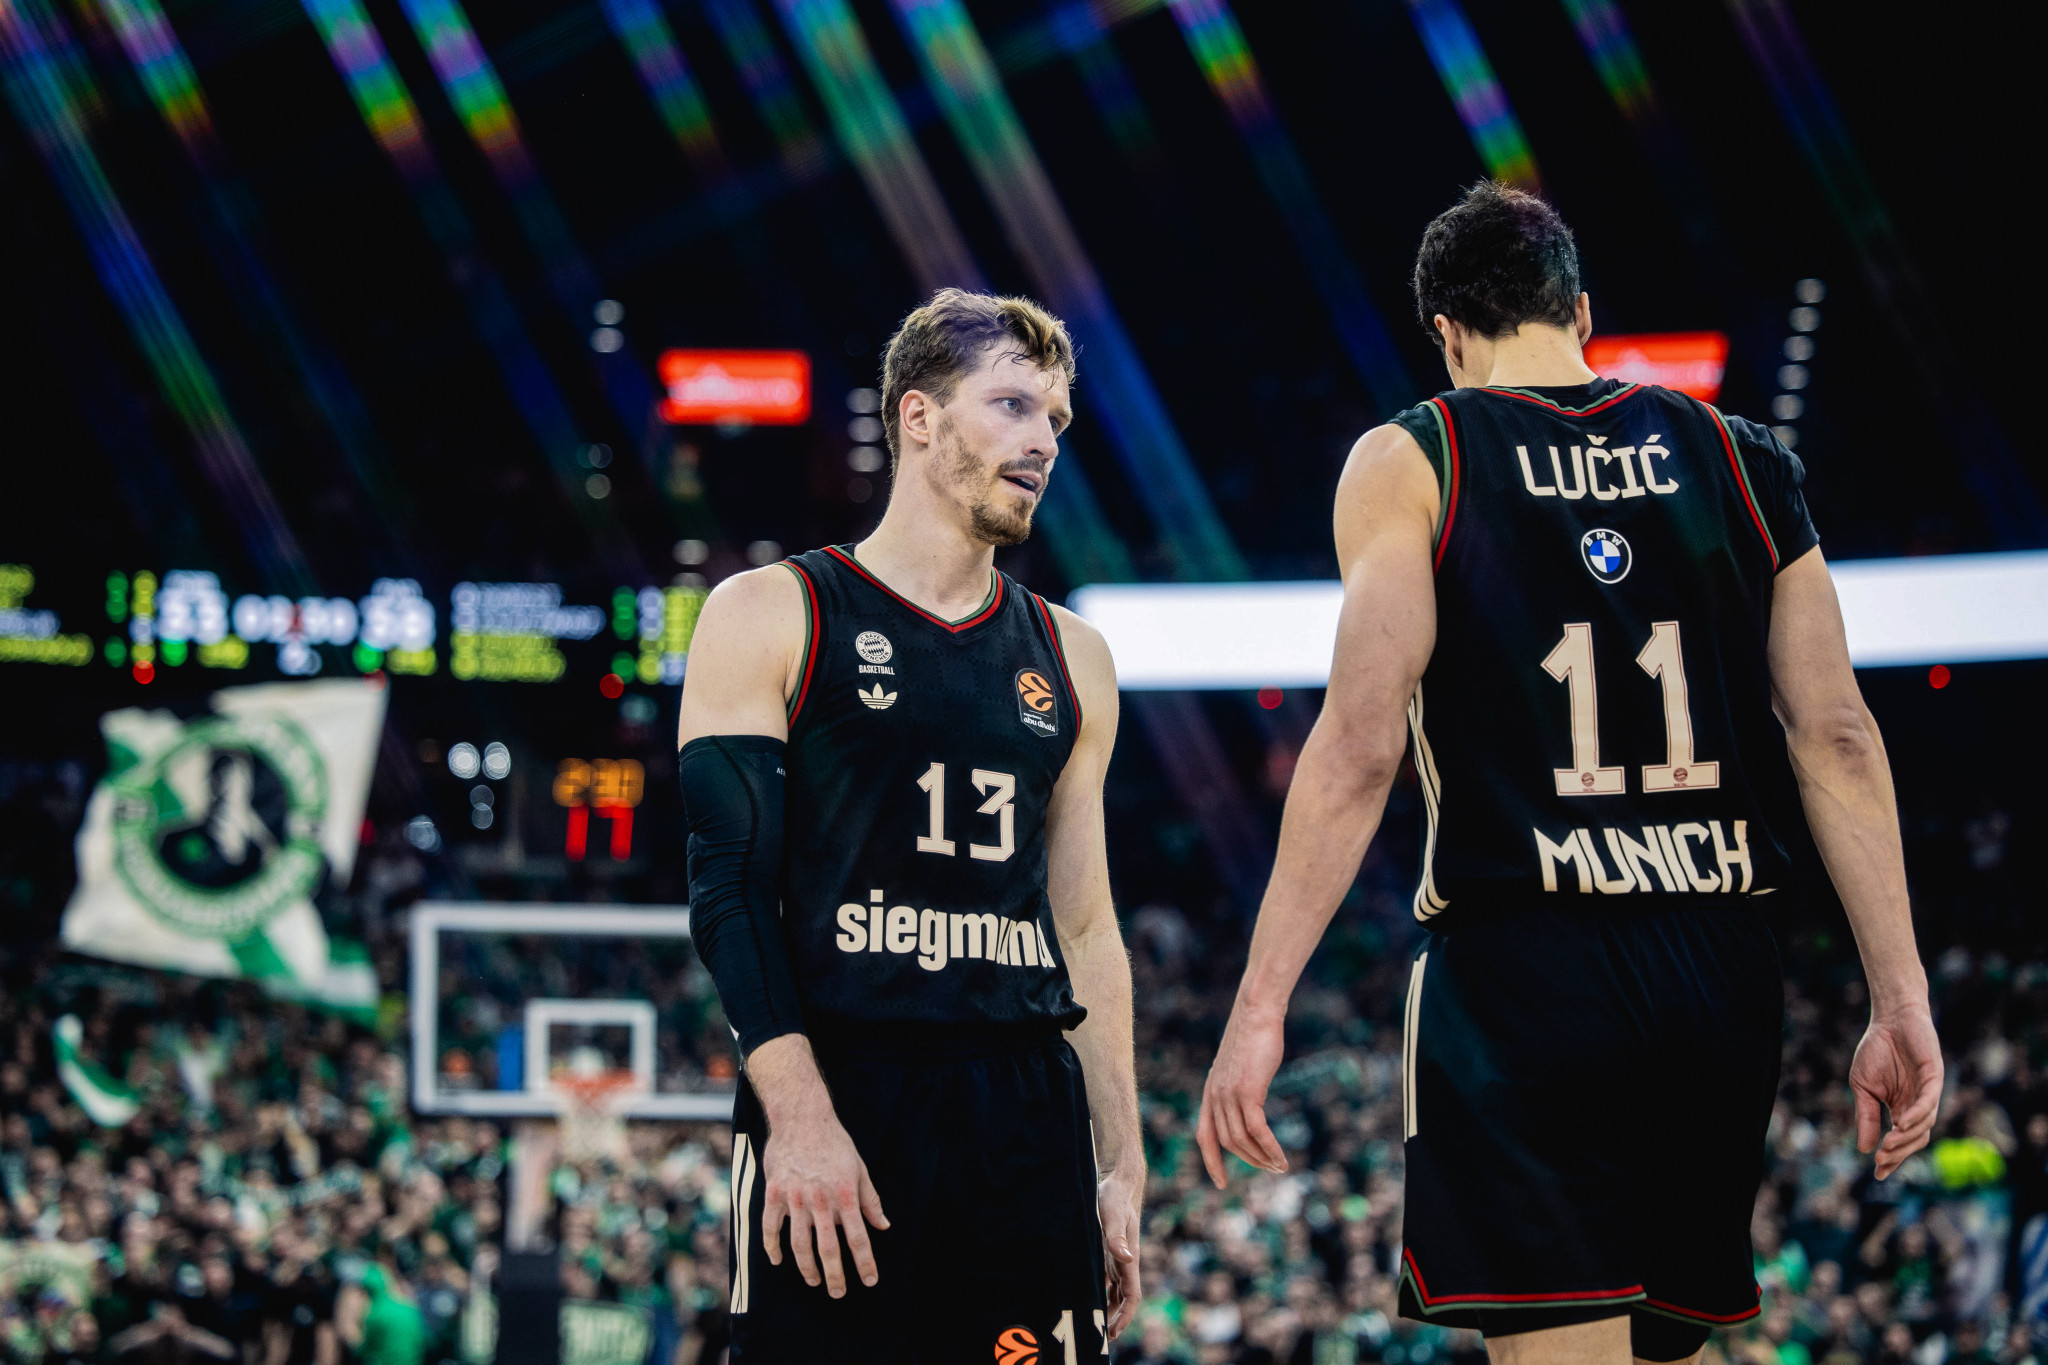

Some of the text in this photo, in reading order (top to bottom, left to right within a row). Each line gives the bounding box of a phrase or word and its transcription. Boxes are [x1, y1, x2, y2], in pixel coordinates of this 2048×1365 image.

[1515, 434, 1680, 501] LUČIĆ
[1584, 531, 1623, 547] BMW
[865, 634, 887, 647] BAYERN
[858, 664, 895, 675] BASKETBALL
[1023, 716, 1037, 726] abu
[1540, 620, 1720, 797] 11
[916, 762, 1015, 862] 13
[1533, 820, 1752, 894] MUNICH
